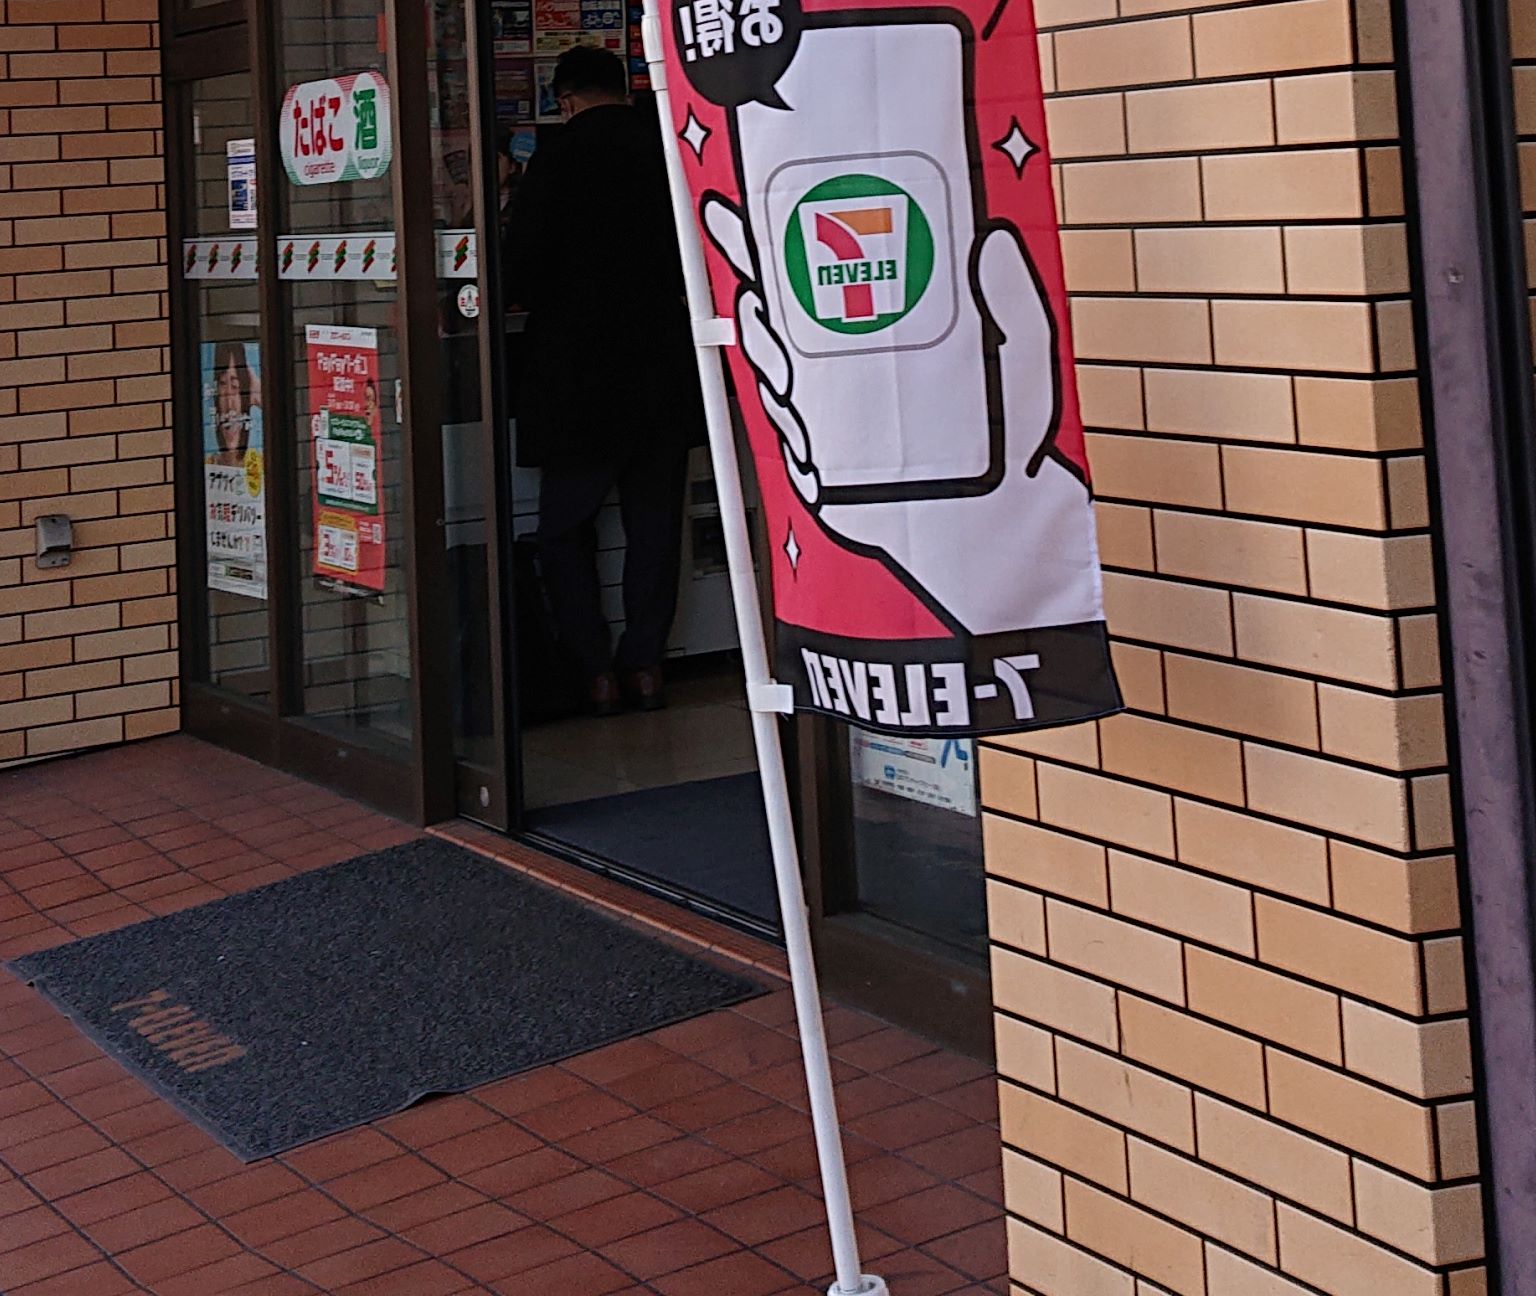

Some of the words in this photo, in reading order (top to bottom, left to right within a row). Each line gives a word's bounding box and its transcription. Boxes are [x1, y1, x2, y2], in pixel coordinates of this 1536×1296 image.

[293, 93, 344, 158] たばこ
[353, 89, 378, 150] 酒
